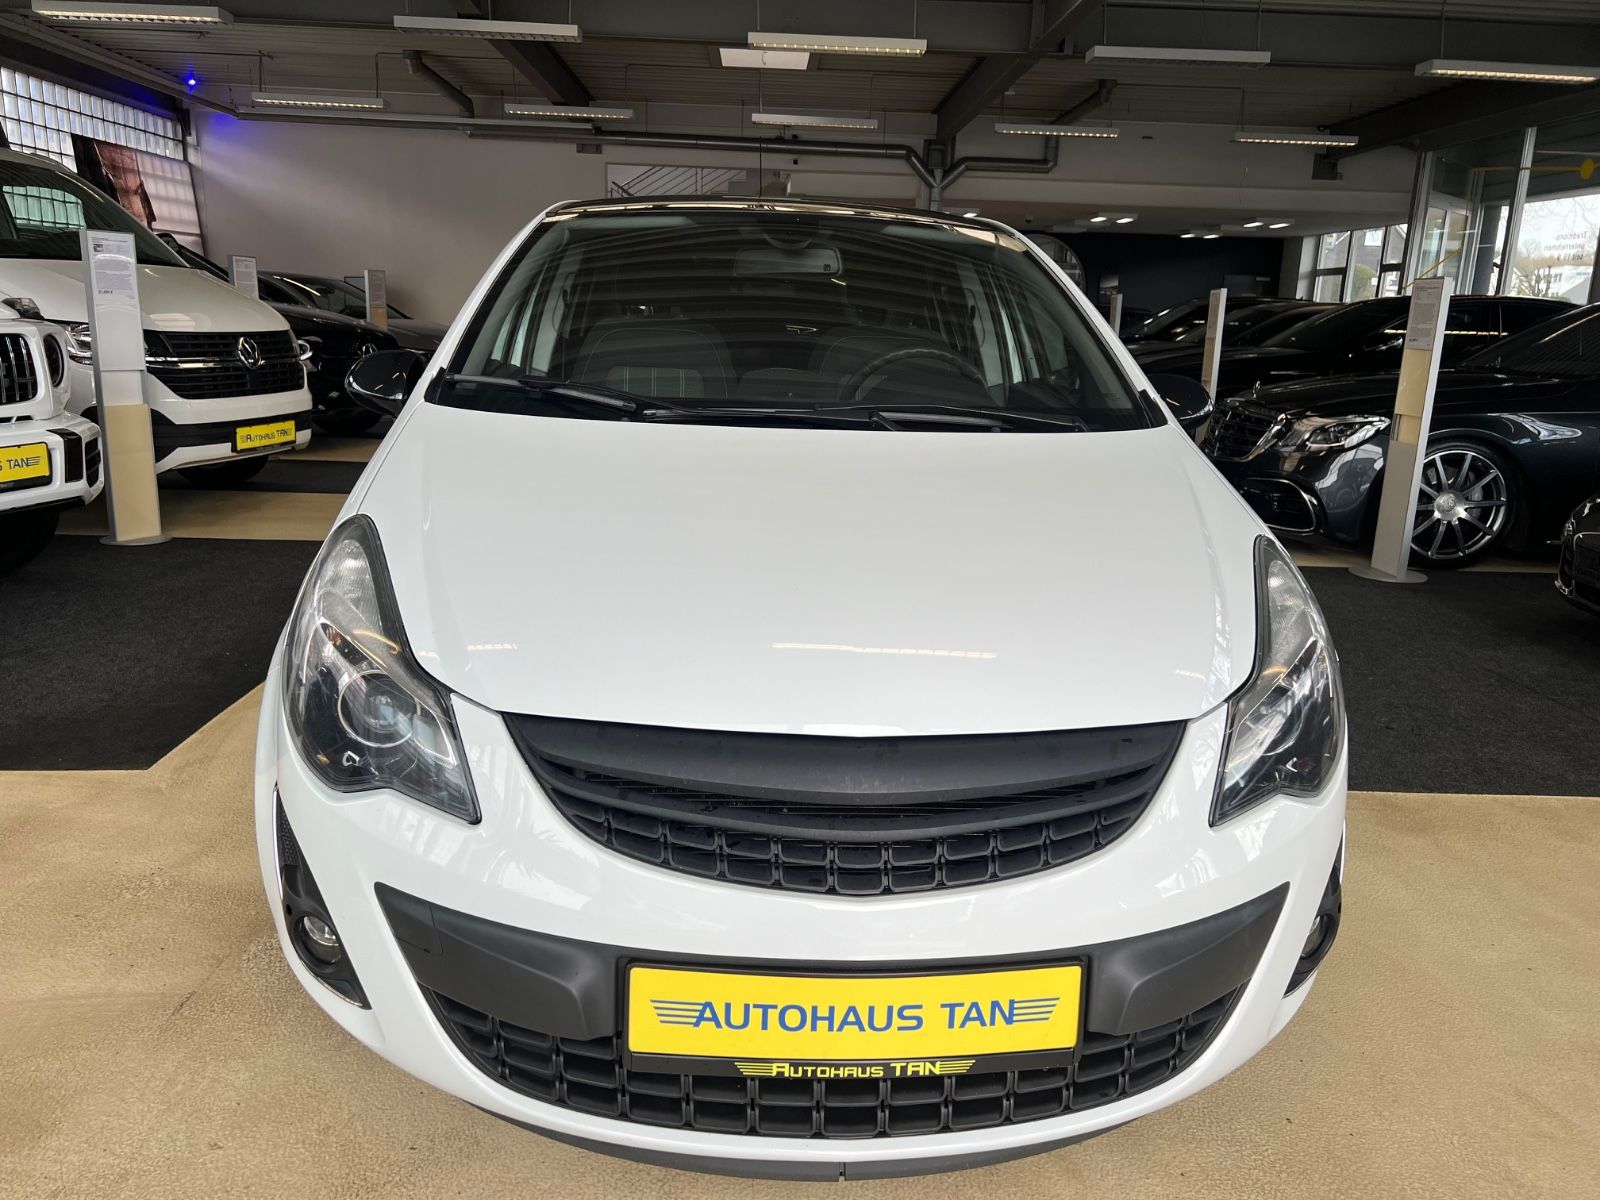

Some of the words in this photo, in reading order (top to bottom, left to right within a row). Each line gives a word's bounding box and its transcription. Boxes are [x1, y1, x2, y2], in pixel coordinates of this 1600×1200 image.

[6, 457, 29, 470] TAN
[692, 1000, 924, 1032] AUTOHAUS
[940, 998, 1016, 1029] TAN
[890, 1060, 941, 1077] TAN
